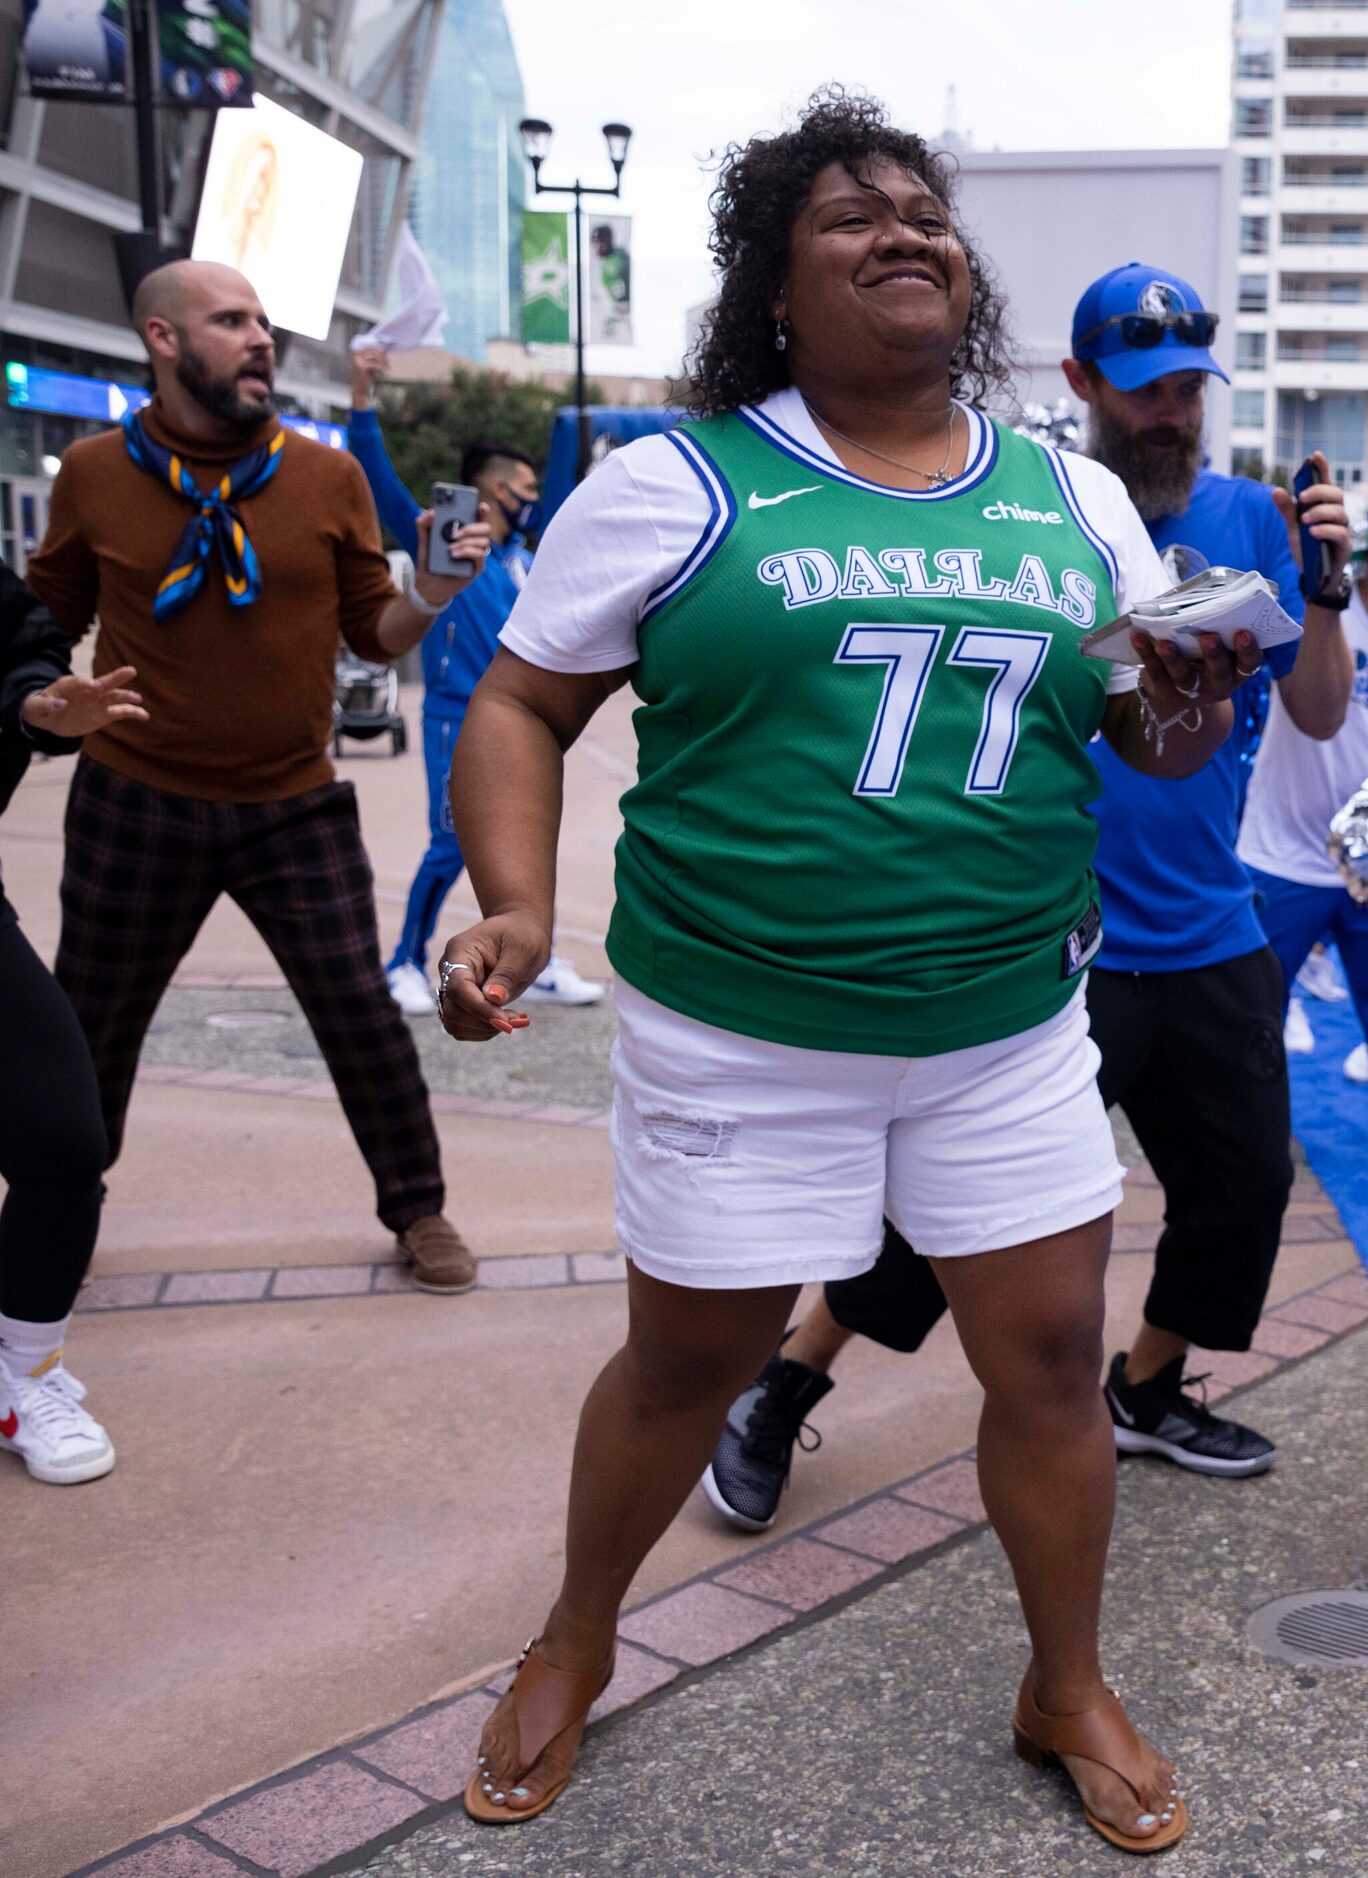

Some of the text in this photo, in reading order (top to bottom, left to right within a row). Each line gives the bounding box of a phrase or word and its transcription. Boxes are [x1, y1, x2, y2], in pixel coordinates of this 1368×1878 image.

[983, 502, 1062, 524] chime
[757, 545, 1098, 629] DALLAS
[834, 623, 1053, 797] 77
